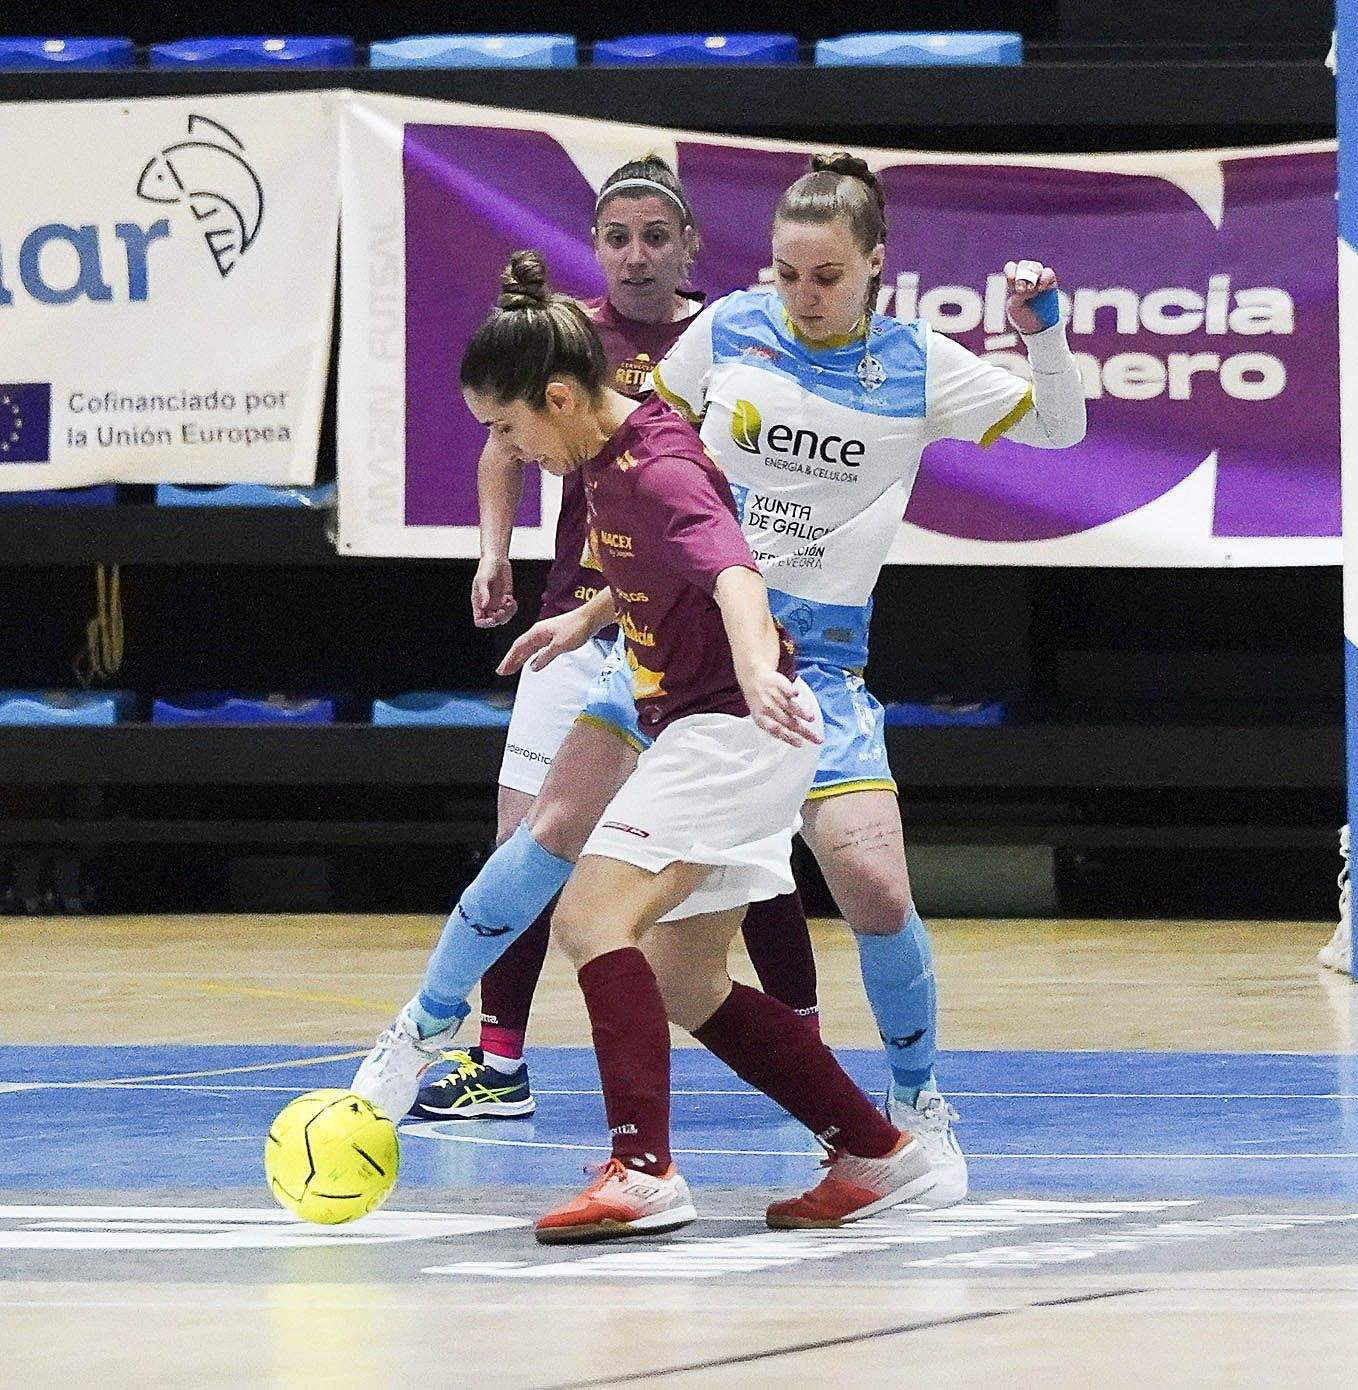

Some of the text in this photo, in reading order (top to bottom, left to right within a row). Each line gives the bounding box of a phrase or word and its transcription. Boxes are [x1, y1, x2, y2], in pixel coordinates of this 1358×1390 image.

[0, 219, 170, 304] ar
[68, 388, 290, 414] Cofinanciado por
[67, 423, 292, 447] la Unión Europea
[767, 424, 865, 467] ence
[751, 494, 812, 521] XUNTA
[748, 511, 835, 542] DE GALIC
